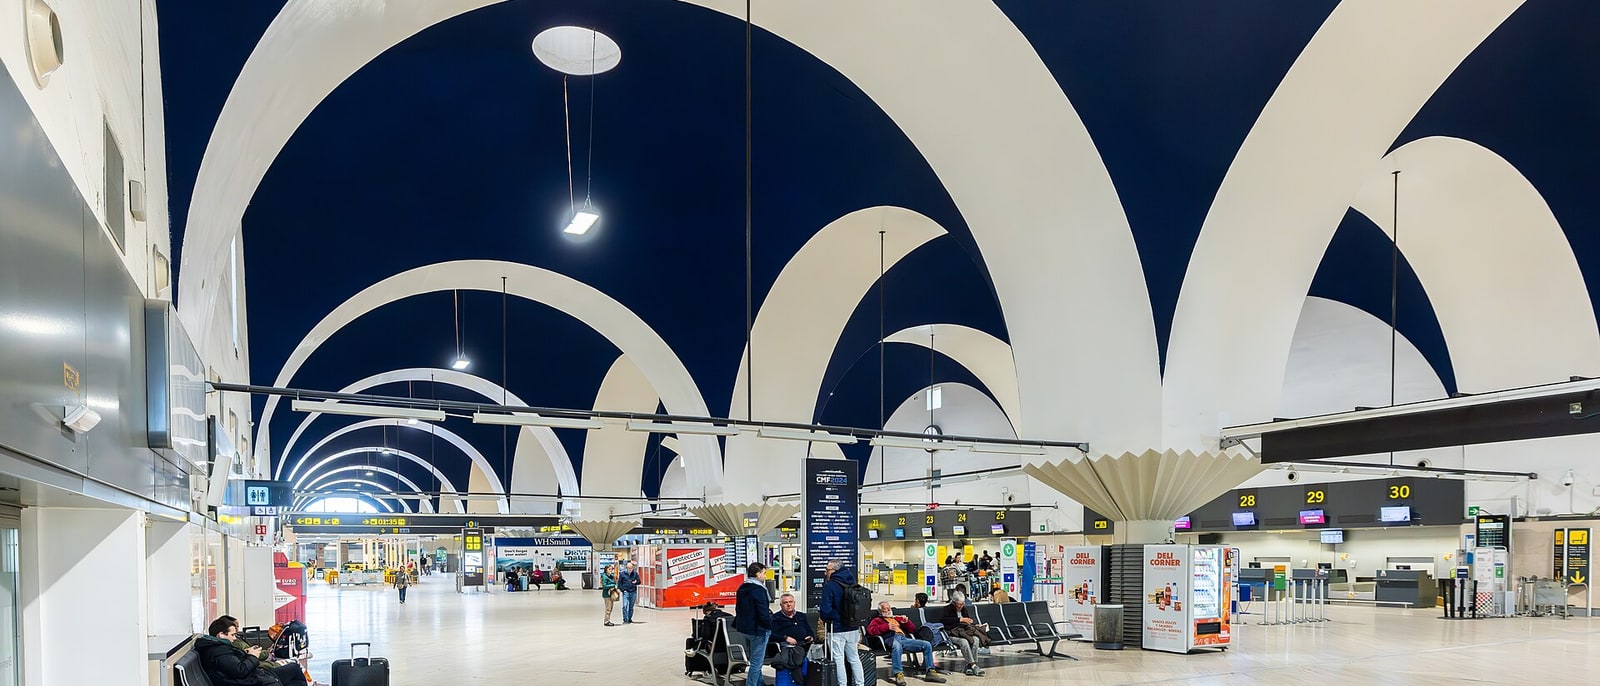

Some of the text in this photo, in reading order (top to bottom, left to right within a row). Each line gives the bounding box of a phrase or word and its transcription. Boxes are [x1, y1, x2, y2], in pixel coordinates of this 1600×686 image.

[1306, 490, 1325, 503] 29
[1389, 485, 1410, 499] 30
[1239, 495, 1256, 507] 28
[926, 515, 934, 524] 23
[958, 513, 967, 522] 24
[995, 511, 1005, 520] 25
[872, 519, 879, 527] 21
[898, 517, 906, 525] 22
[1150, 559, 1181, 567] CORNER
